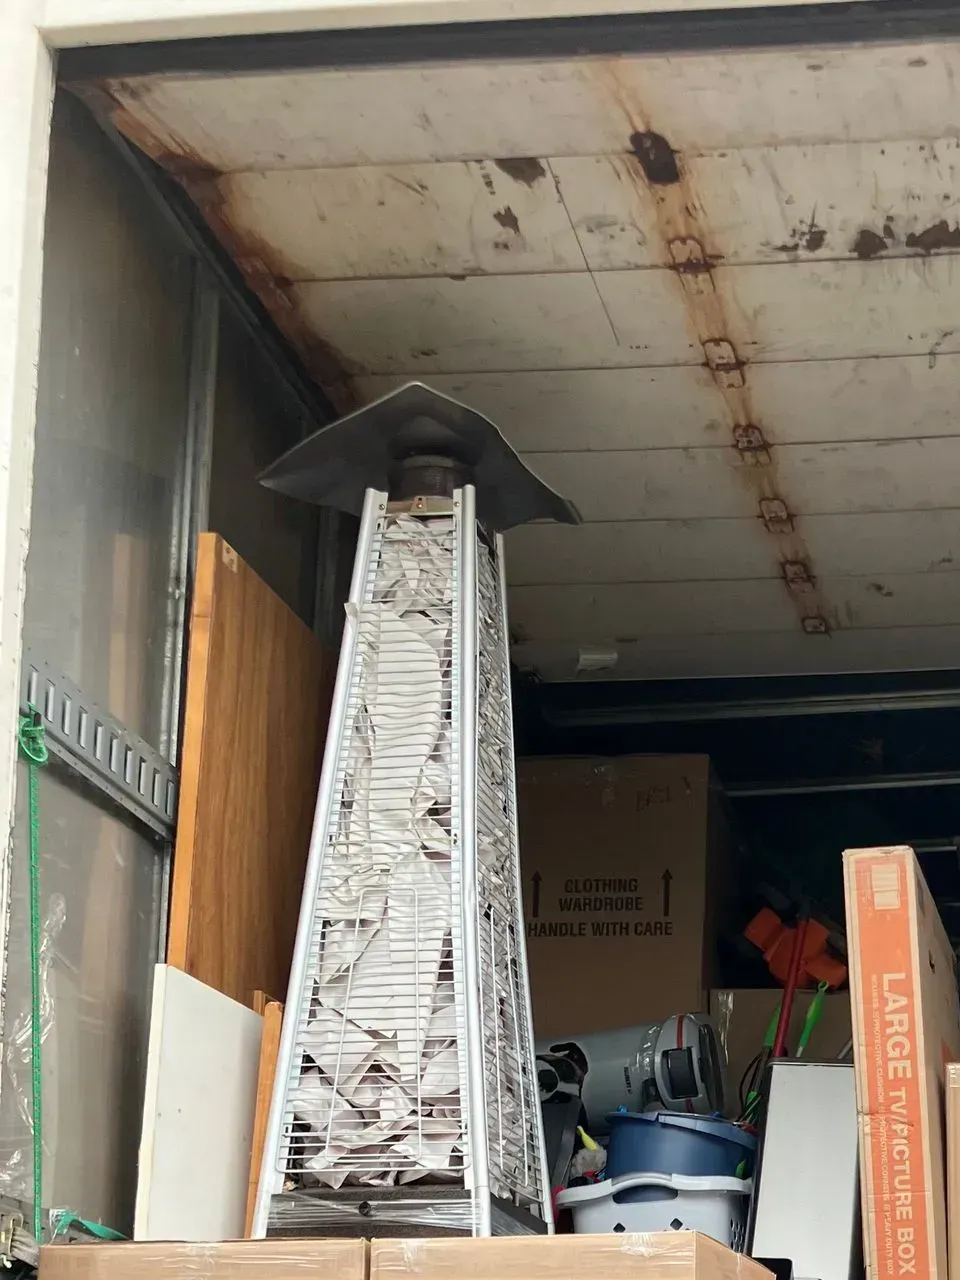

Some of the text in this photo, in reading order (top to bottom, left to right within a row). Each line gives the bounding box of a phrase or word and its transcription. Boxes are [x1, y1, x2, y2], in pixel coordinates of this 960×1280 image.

[564, 878, 638, 893] CLOTHING
[558, 897, 644, 912] WARDROBE
[527, 921, 673, 937] HANDLE WITH CARE
[882, 972, 916, 1275] LARGE TV/PICTURE BOX
